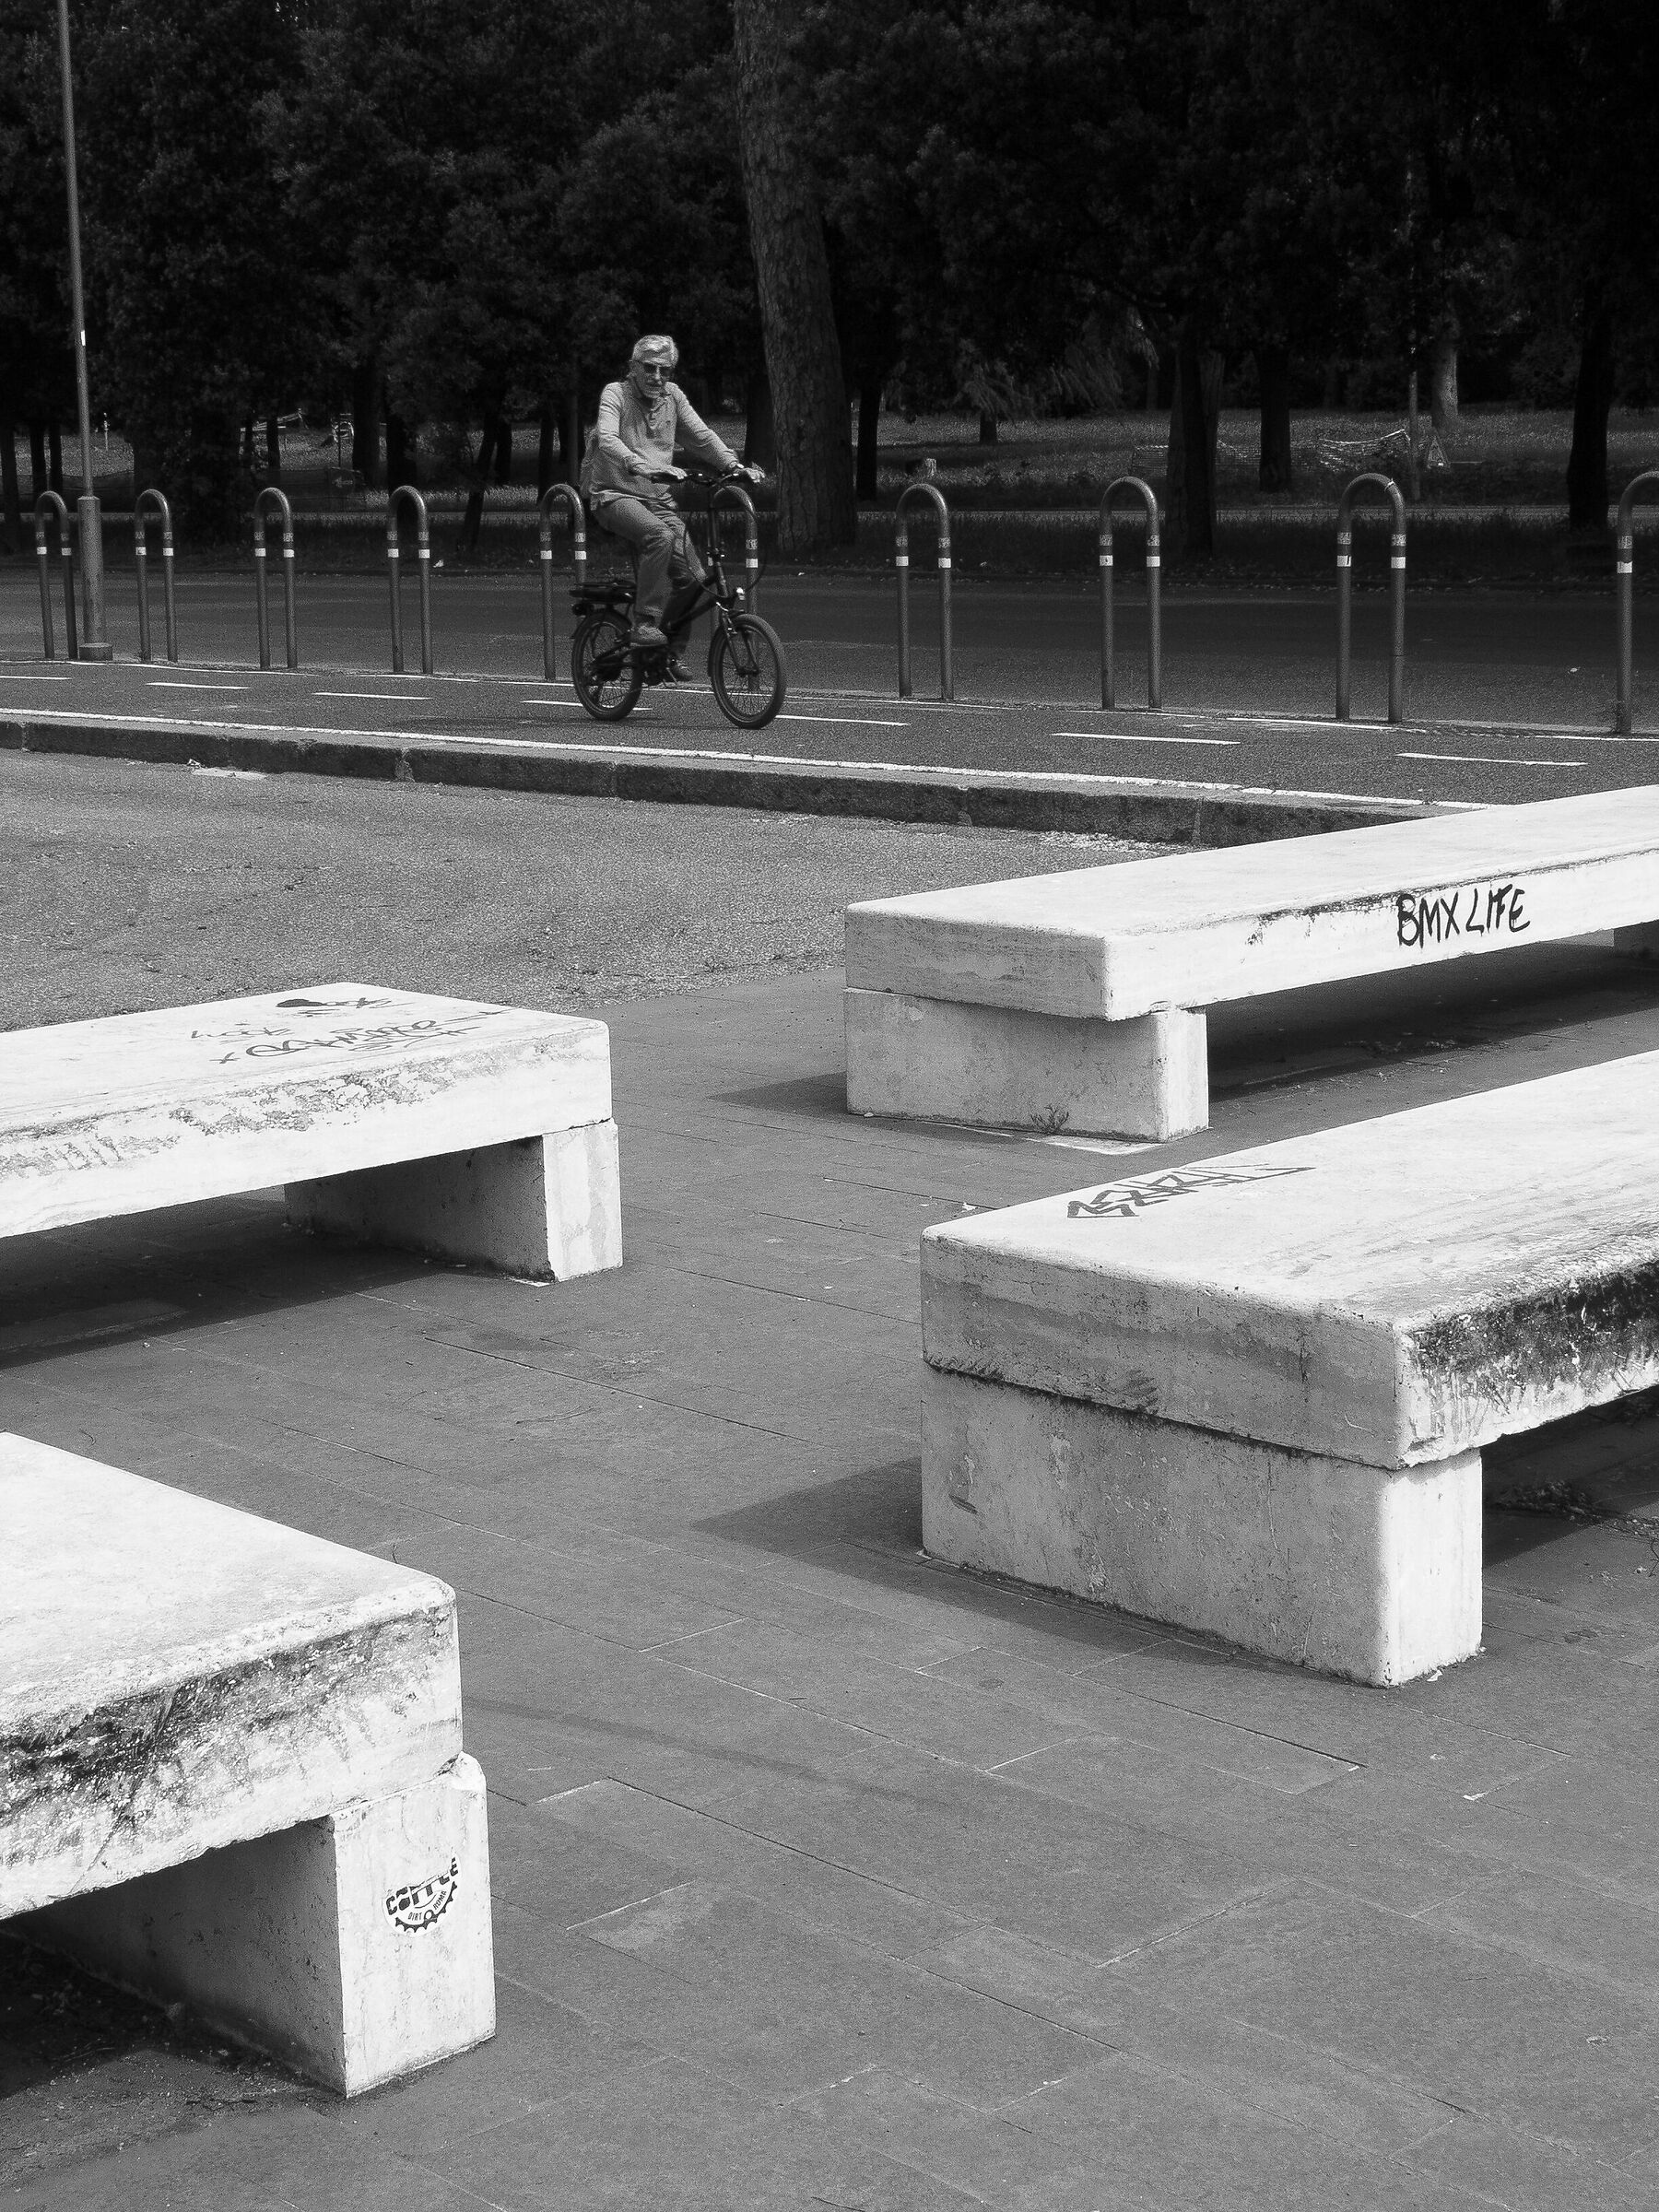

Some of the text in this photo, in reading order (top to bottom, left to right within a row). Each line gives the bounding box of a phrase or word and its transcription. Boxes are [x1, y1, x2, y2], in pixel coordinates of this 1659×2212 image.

[1397, 883, 1530, 948] BMX LIFE
[407, 1890, 447, 1922] DIRT ROMA
